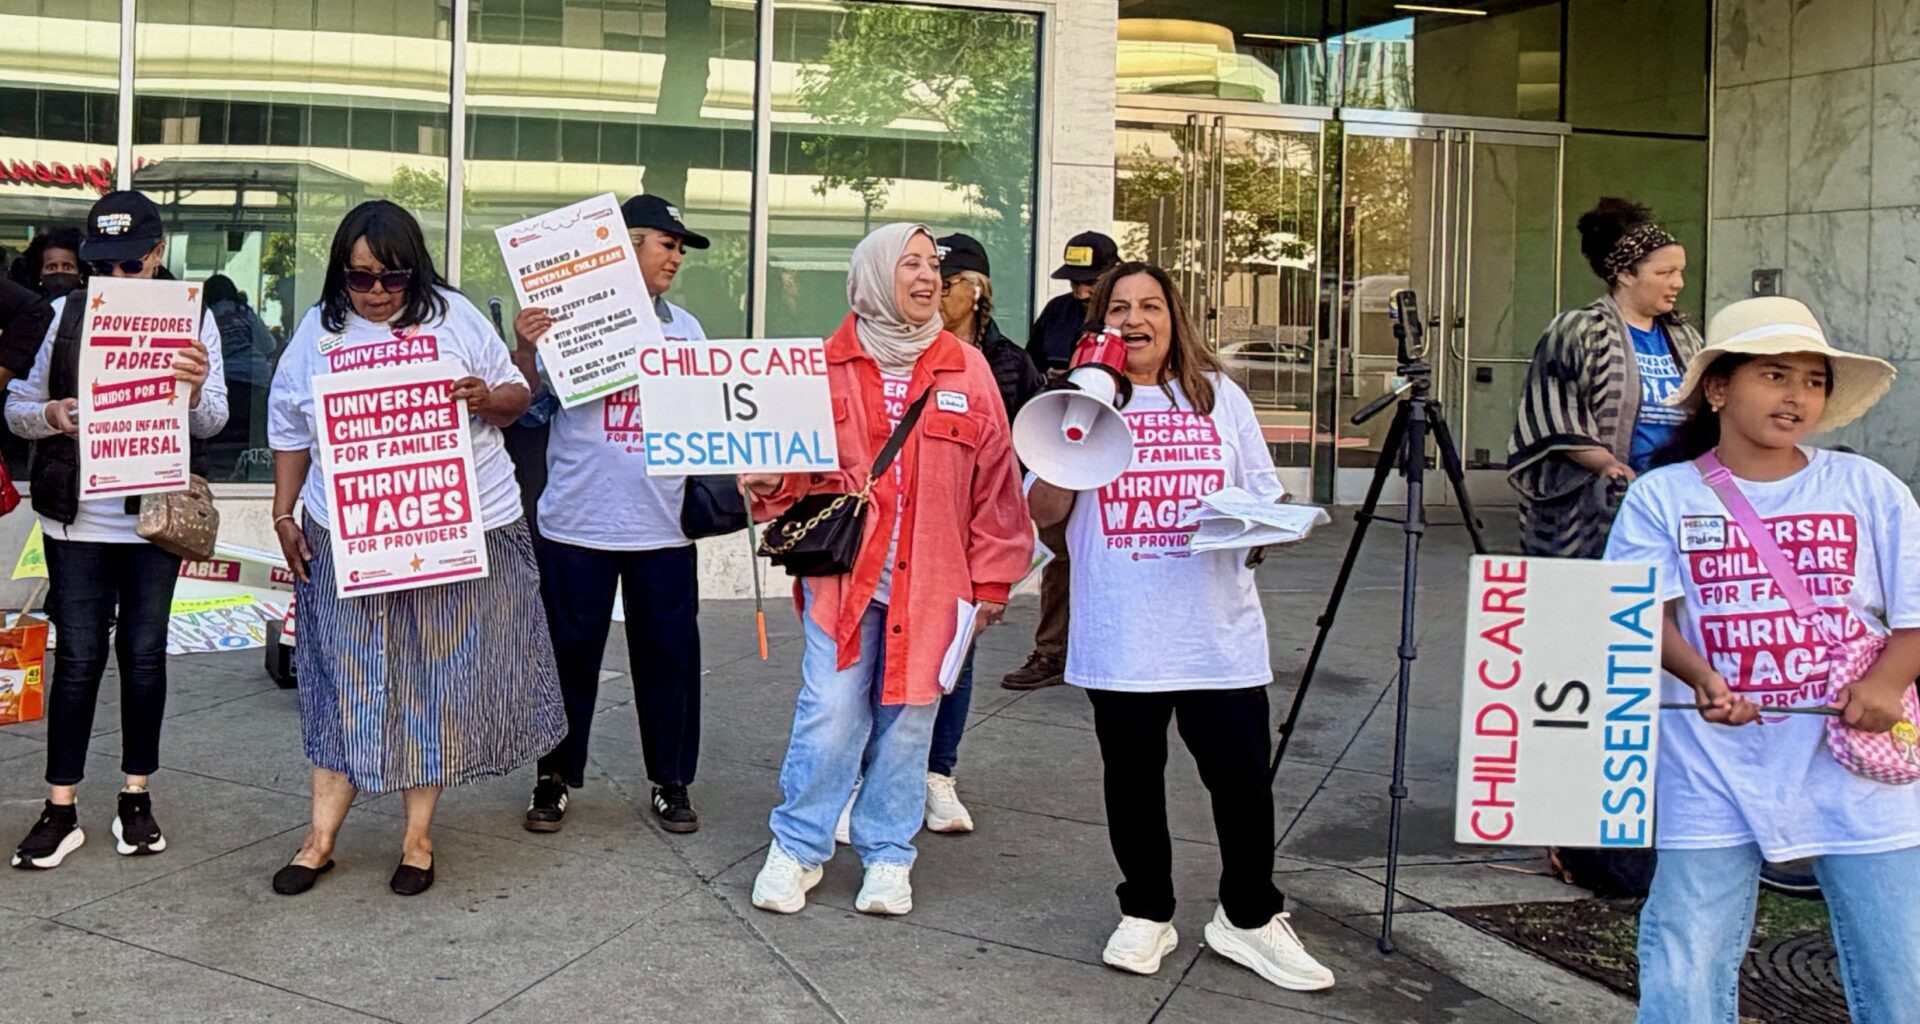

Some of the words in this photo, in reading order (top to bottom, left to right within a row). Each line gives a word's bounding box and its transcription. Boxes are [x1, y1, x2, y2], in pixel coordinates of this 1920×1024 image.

[519, 265, 532, 275] WE
[535, 252, 570, 270] DEMAND
[574, 249, 580, 257] A
[523, 267, 572, 289] UNIVERSAL
[573, 258, 597, 273] CHILD
[528, 285, 563, 303] SYSTEM
[561, 298, 585, 312] EVERY
[587, 290, 608, 304] CHILD
[92, 316, 192, 333] PROVEEDORES
[554, 329, 572, 340] WITH
[573, 317, 606, 333] THRIVING
[607, 308, 632, 322] WAGES
[138, 336, 148, 348] Y
[558, 339, 571, 349] FOR
[573, 331, 597, 344] EARLY
[561, 339, 604, 358] EDUCATORS
[105, 352, 173, 370] PADRES
[333, 339, 434, 369] UNIVERSAL
[640, 348, 732, 376] CHILD
[740, 348, 827, 376] CARE
[569, 365, 583, 376] AND
[94, 388, 131, 407] UNIDOS
[134, 384, 158, 399] POR
[160, 382, 172, 395] EL
[328, 383, 454, 418] UNIVERSAL
[722, 382, 758, 422] IS
[88, 420, 132, 435] CUIDADO
[135, 418, 180, 432] INFANTIL
[334, 409, 451, 440] CHILDCARE
[1125, 413, 1212, 428] VERSAL
[91, 435, 181, 460] UNIVERSAL
[334, 445, 368, 464] FOR
[377, 433, 459, 459] FAMILIES
[606, 433, 627, 442] FOR
[645, 431, 834, 466] ESSENTIAL
[1133, 428, 1213, 443] LDCARE
[1138, 447, 1222, 463] FAMILIES
[339, 463, 459, 501] THRIVING
[342, 491, 463, 537] WAGES
[348, 539, 378, 555] FOR
[384, 525, 468, 549] PROVIDERS
[1107, 537, 1132, 549] FOR
[1139, 534, 1190, 548] PROVID
[1700, 585, 1739, 605] FOR
[1751, 578, 1854, 600] FAILIES
[1478, 560, 1528, 690] CARE
[1532, 680, 1590, 729] IS
[1600, 567, 1657, 845] ESSENTIAL
[1471, 703, 1519, 841] CHILD
